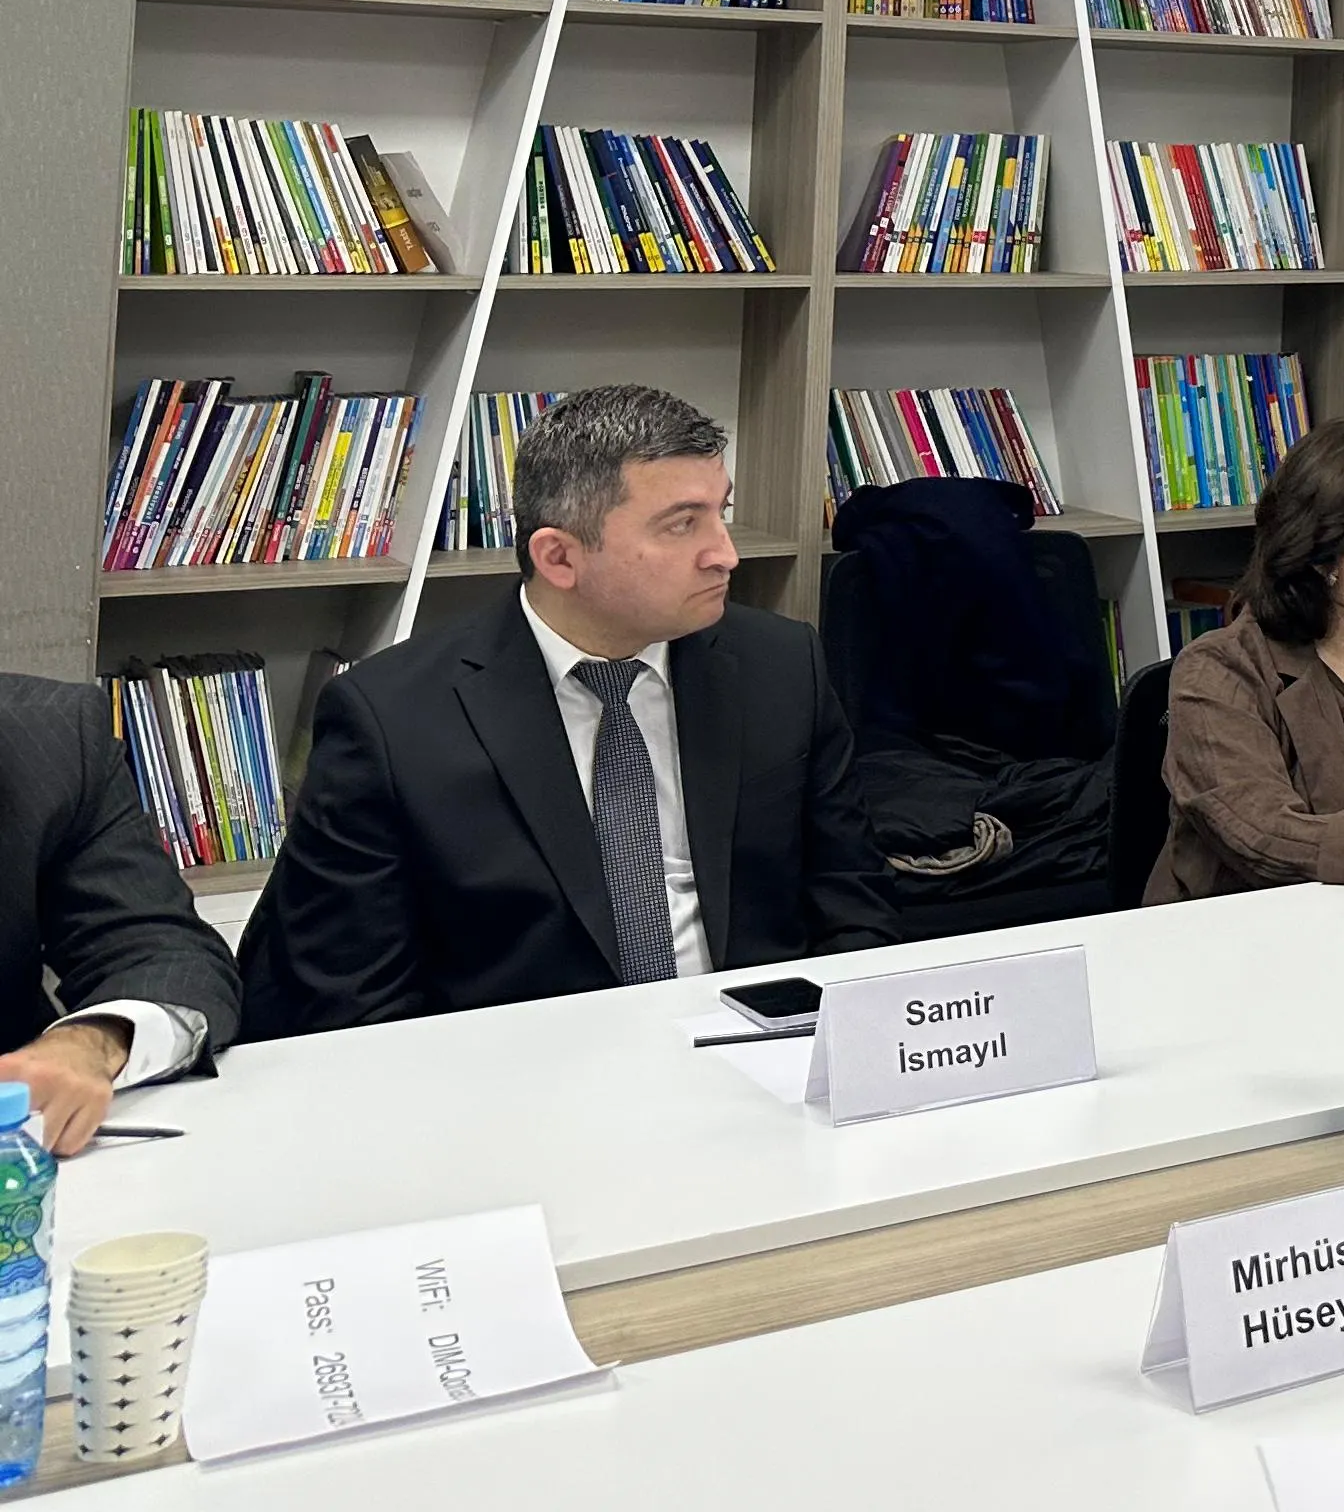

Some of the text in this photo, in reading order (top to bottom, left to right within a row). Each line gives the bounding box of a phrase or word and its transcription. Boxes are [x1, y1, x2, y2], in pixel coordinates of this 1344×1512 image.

[905, 991, 995, 1027] Samir
[899, 1032, 1009, 1074] İsmayıl
[303, 1278, 336, 1337] Pass:
[415, 1258, 451, 1313] WiFi:
